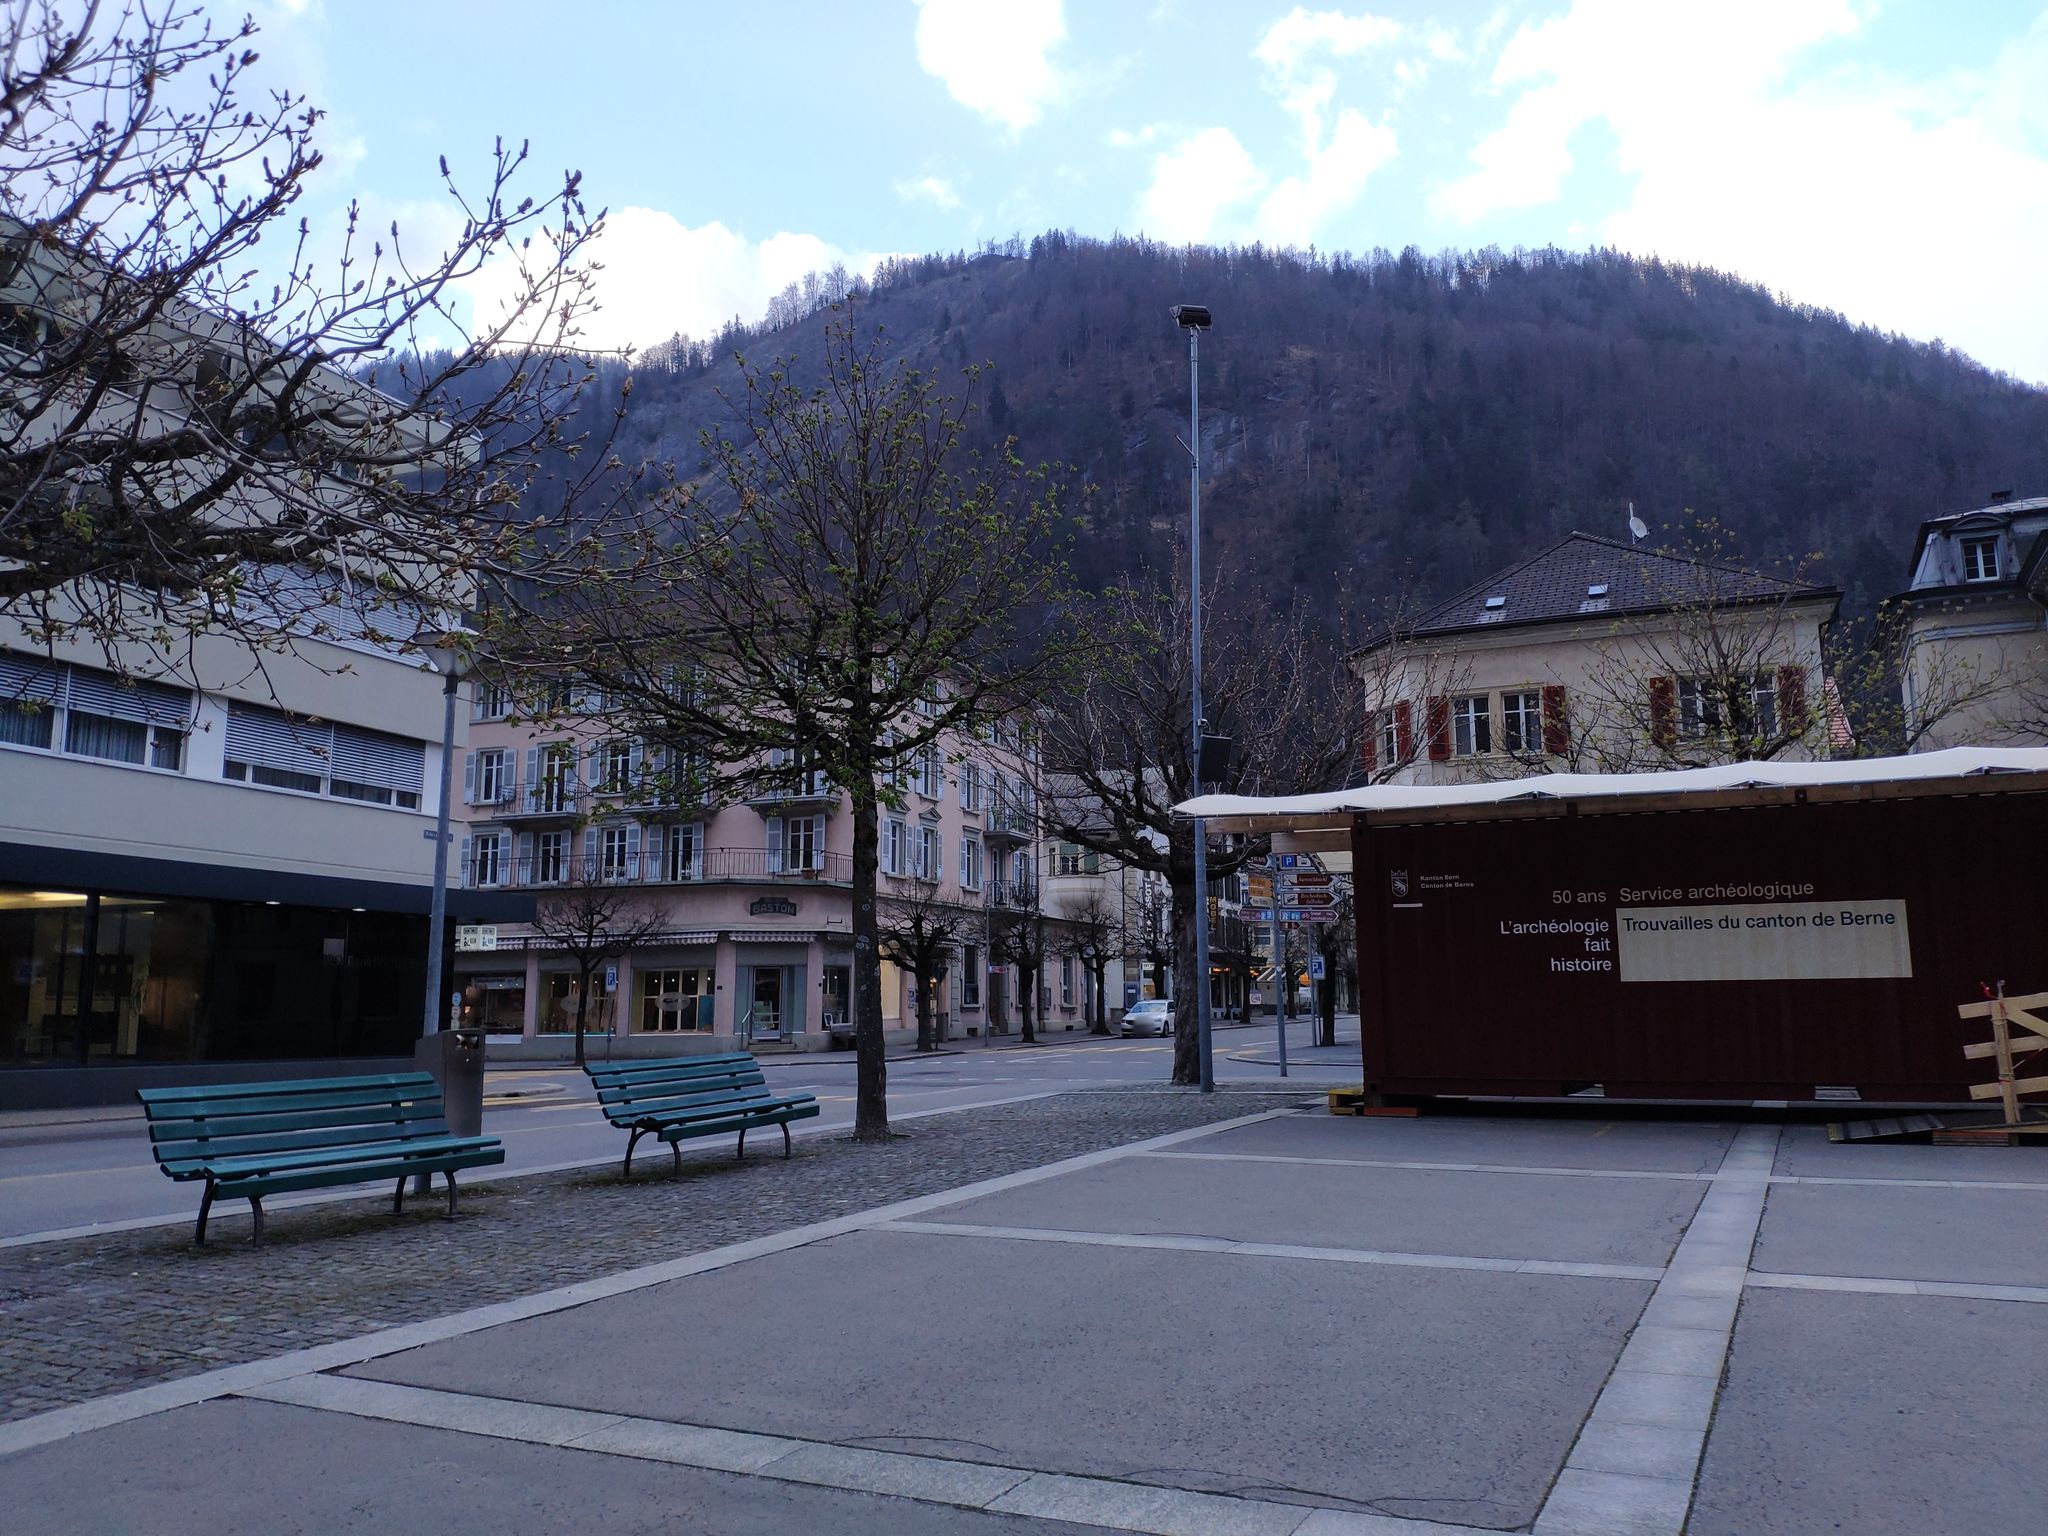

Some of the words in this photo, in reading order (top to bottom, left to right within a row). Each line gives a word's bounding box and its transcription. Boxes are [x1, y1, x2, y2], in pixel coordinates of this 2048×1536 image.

[1286, 857, 1292, 866] P
[1454, 880, 1475, 888] Berne
[1552, 890, 1572, 904] 50
[1577, 891, 1607, 903] ans
[1620, 886, 1683, 902] Service
[1688, 881, 1815, 900] archéologique
[1500, 919, 1610, 936] L'archéologie
[1623, 916, 1714, 932] Trouvailles
[1718, 915, 1740, 930] du
[1745, 913, 1807, 929] canton
[1812, 912, 1836, 927] de
[1841, 911, 1896, 926] Berne
[1584, 938, 1611, 952] fait
[1551, 957, 1613, 972] histoire
